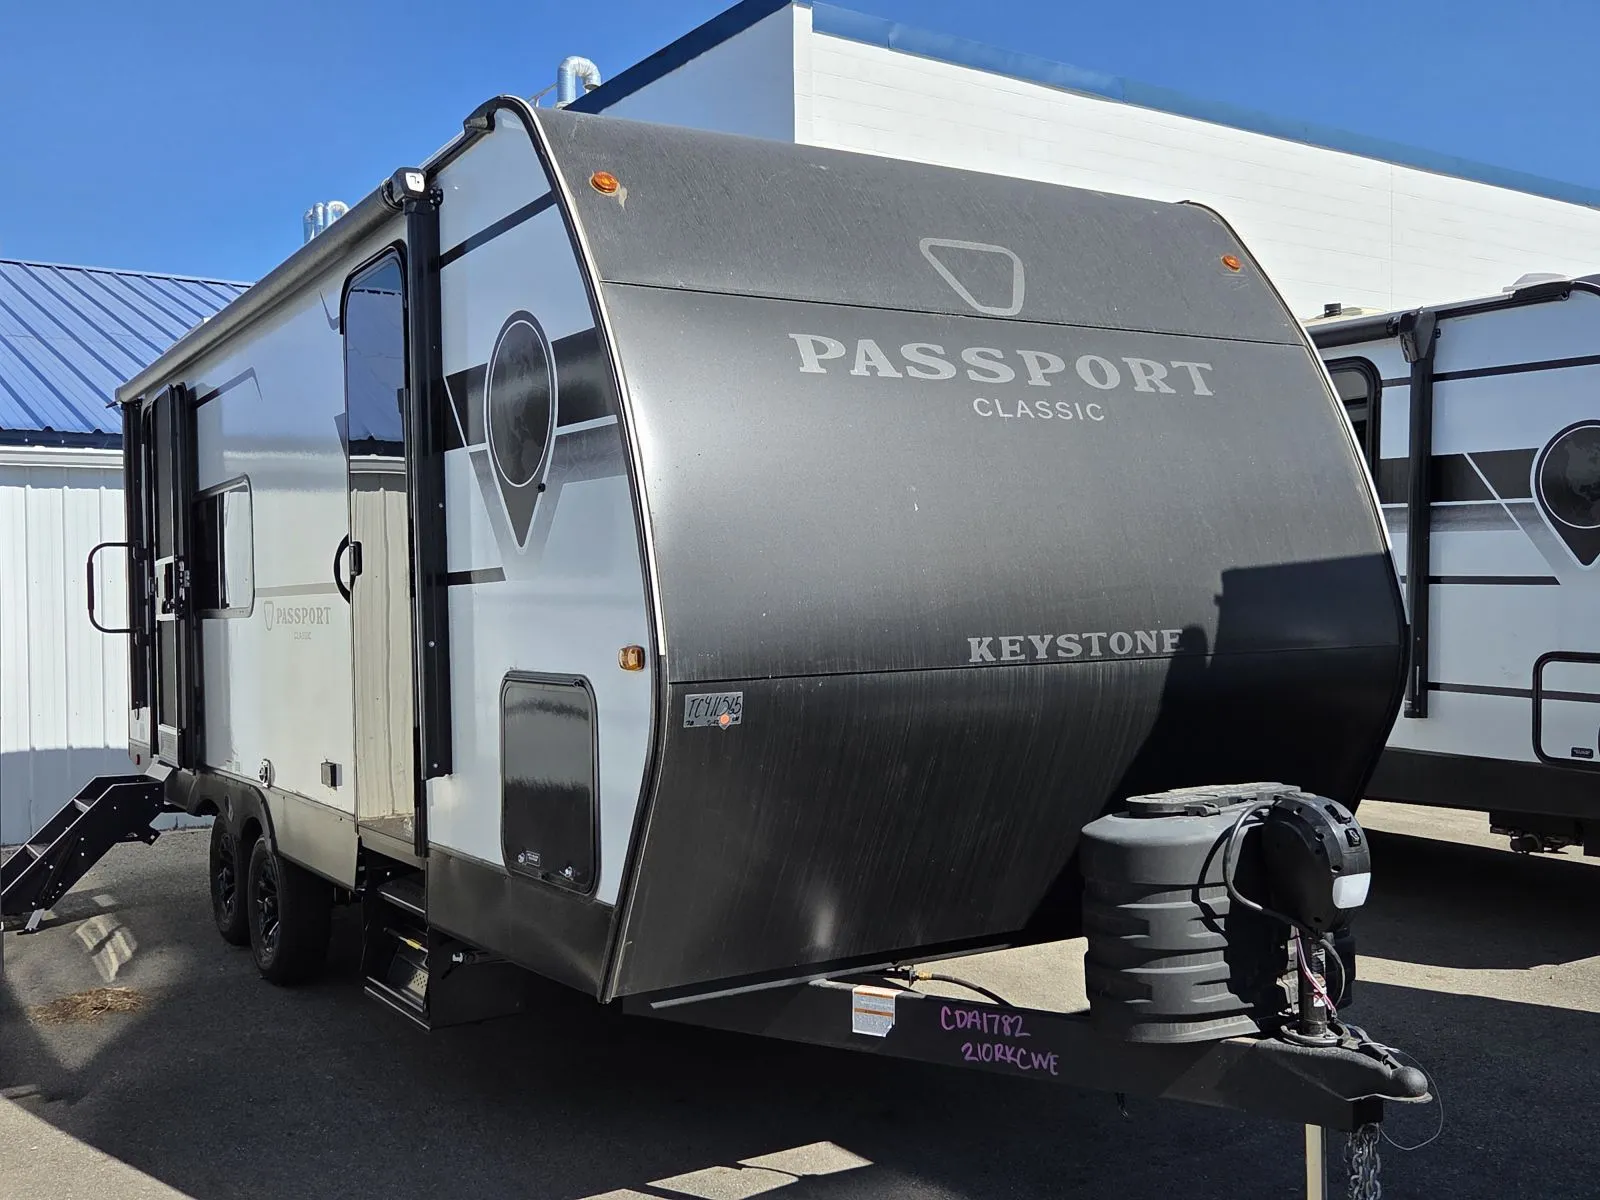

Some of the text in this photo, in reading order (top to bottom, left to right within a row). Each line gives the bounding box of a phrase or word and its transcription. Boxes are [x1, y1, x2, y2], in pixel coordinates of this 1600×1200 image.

[788, 333, 1214, 396] PASSPORT
[973, 397, 1105, 422] CLASSIC
[276, 606, 331, 625] PASSPORT
[967, 628, 1184, 663] KEYSTONE
[940, 1005, 1031, 1038] CDA1782
